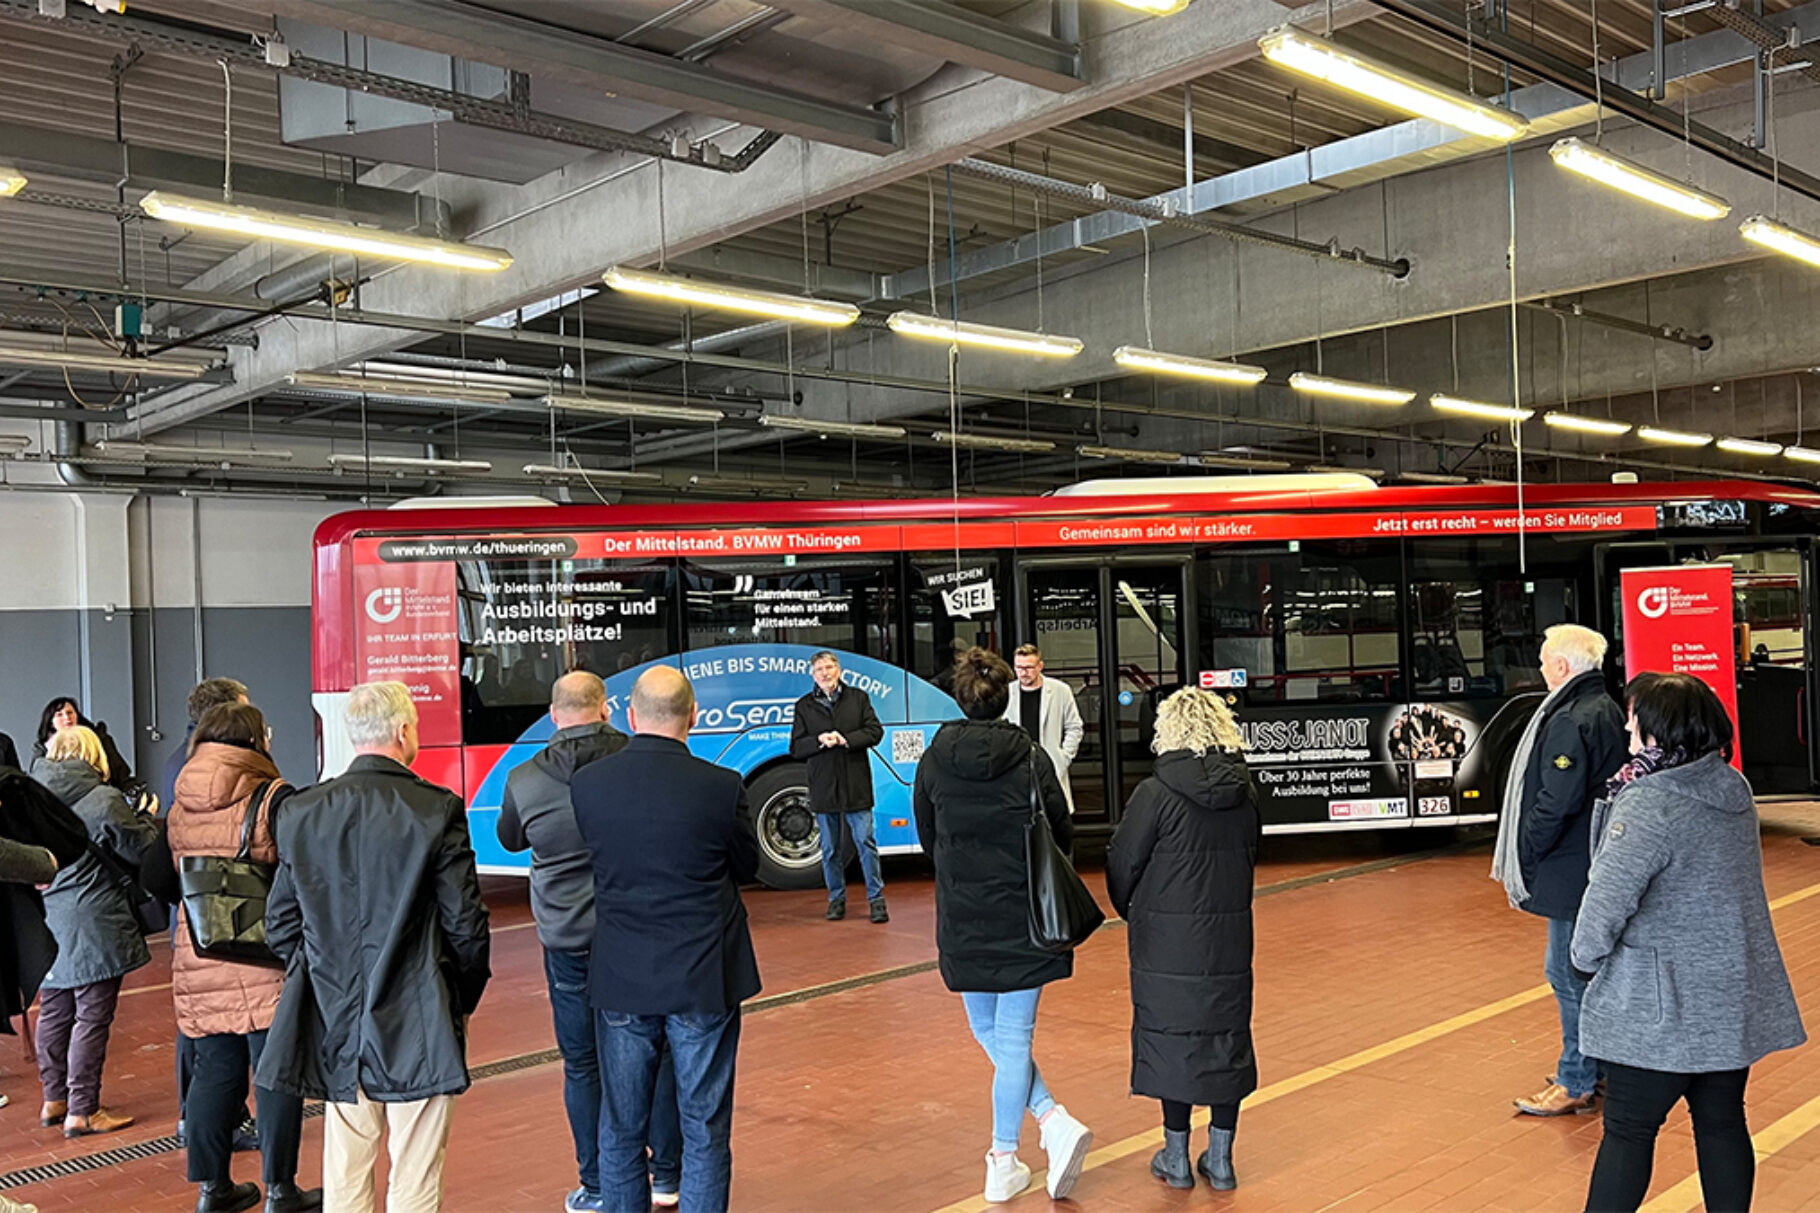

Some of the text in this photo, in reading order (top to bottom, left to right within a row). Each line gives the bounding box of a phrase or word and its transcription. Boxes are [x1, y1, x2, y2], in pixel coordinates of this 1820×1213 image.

[1373, 518, 1408, 531] Jetzt
[1412, 517, 1438, 530] erst
[1441, 516, 1476, 529] recht
[1493, 515, 1541, 528] werden
[1544, 513, 1565, 527] Sie
[1568, 512, 1622, 528] Mitglied
[1059, 522, 1256, 540] Gemeinsam sind wir stärker.
[392, 541, 566, 557] www.bvmw.de/thueringen
[605, 533, 861, 552] Der Mittelstand. BVMW Thüringen
[928, 567, 984, 586] WIR SUCHEN
[481, 580, 622, 594] Wir bieten interessante
[754, 601, 848, 614] für einen starken
[952, 588, 986, 610] SIE!
[481, 597, 657, 620] Ausbildungs- und
[755, 615, 822, 628] Mittelstand.
[384, 633, 410, 642] TEAM
[411, 633, 420, 641] IN
[422, 632, 458, 641] ERFURT
[482, 623, 622, 646] Arbeitsplätze!
[367, 653, 449, 665] Gerald Bitterberg
[728, 657, 754, 673] BIS
[840, 669, 893, 699] CTORY
[692, 698, 796, 730] roSens
[1240, 718, 1370, 750] USS&JANOT
[1258, 766, 1371, 783] Über 30 Jahre perfekte
[1272, 781, 1371, 797] Ausbildung bei uns!
[1378, 801, 1404, 814] VMT
[1421, 799, 1448, 813] 326
